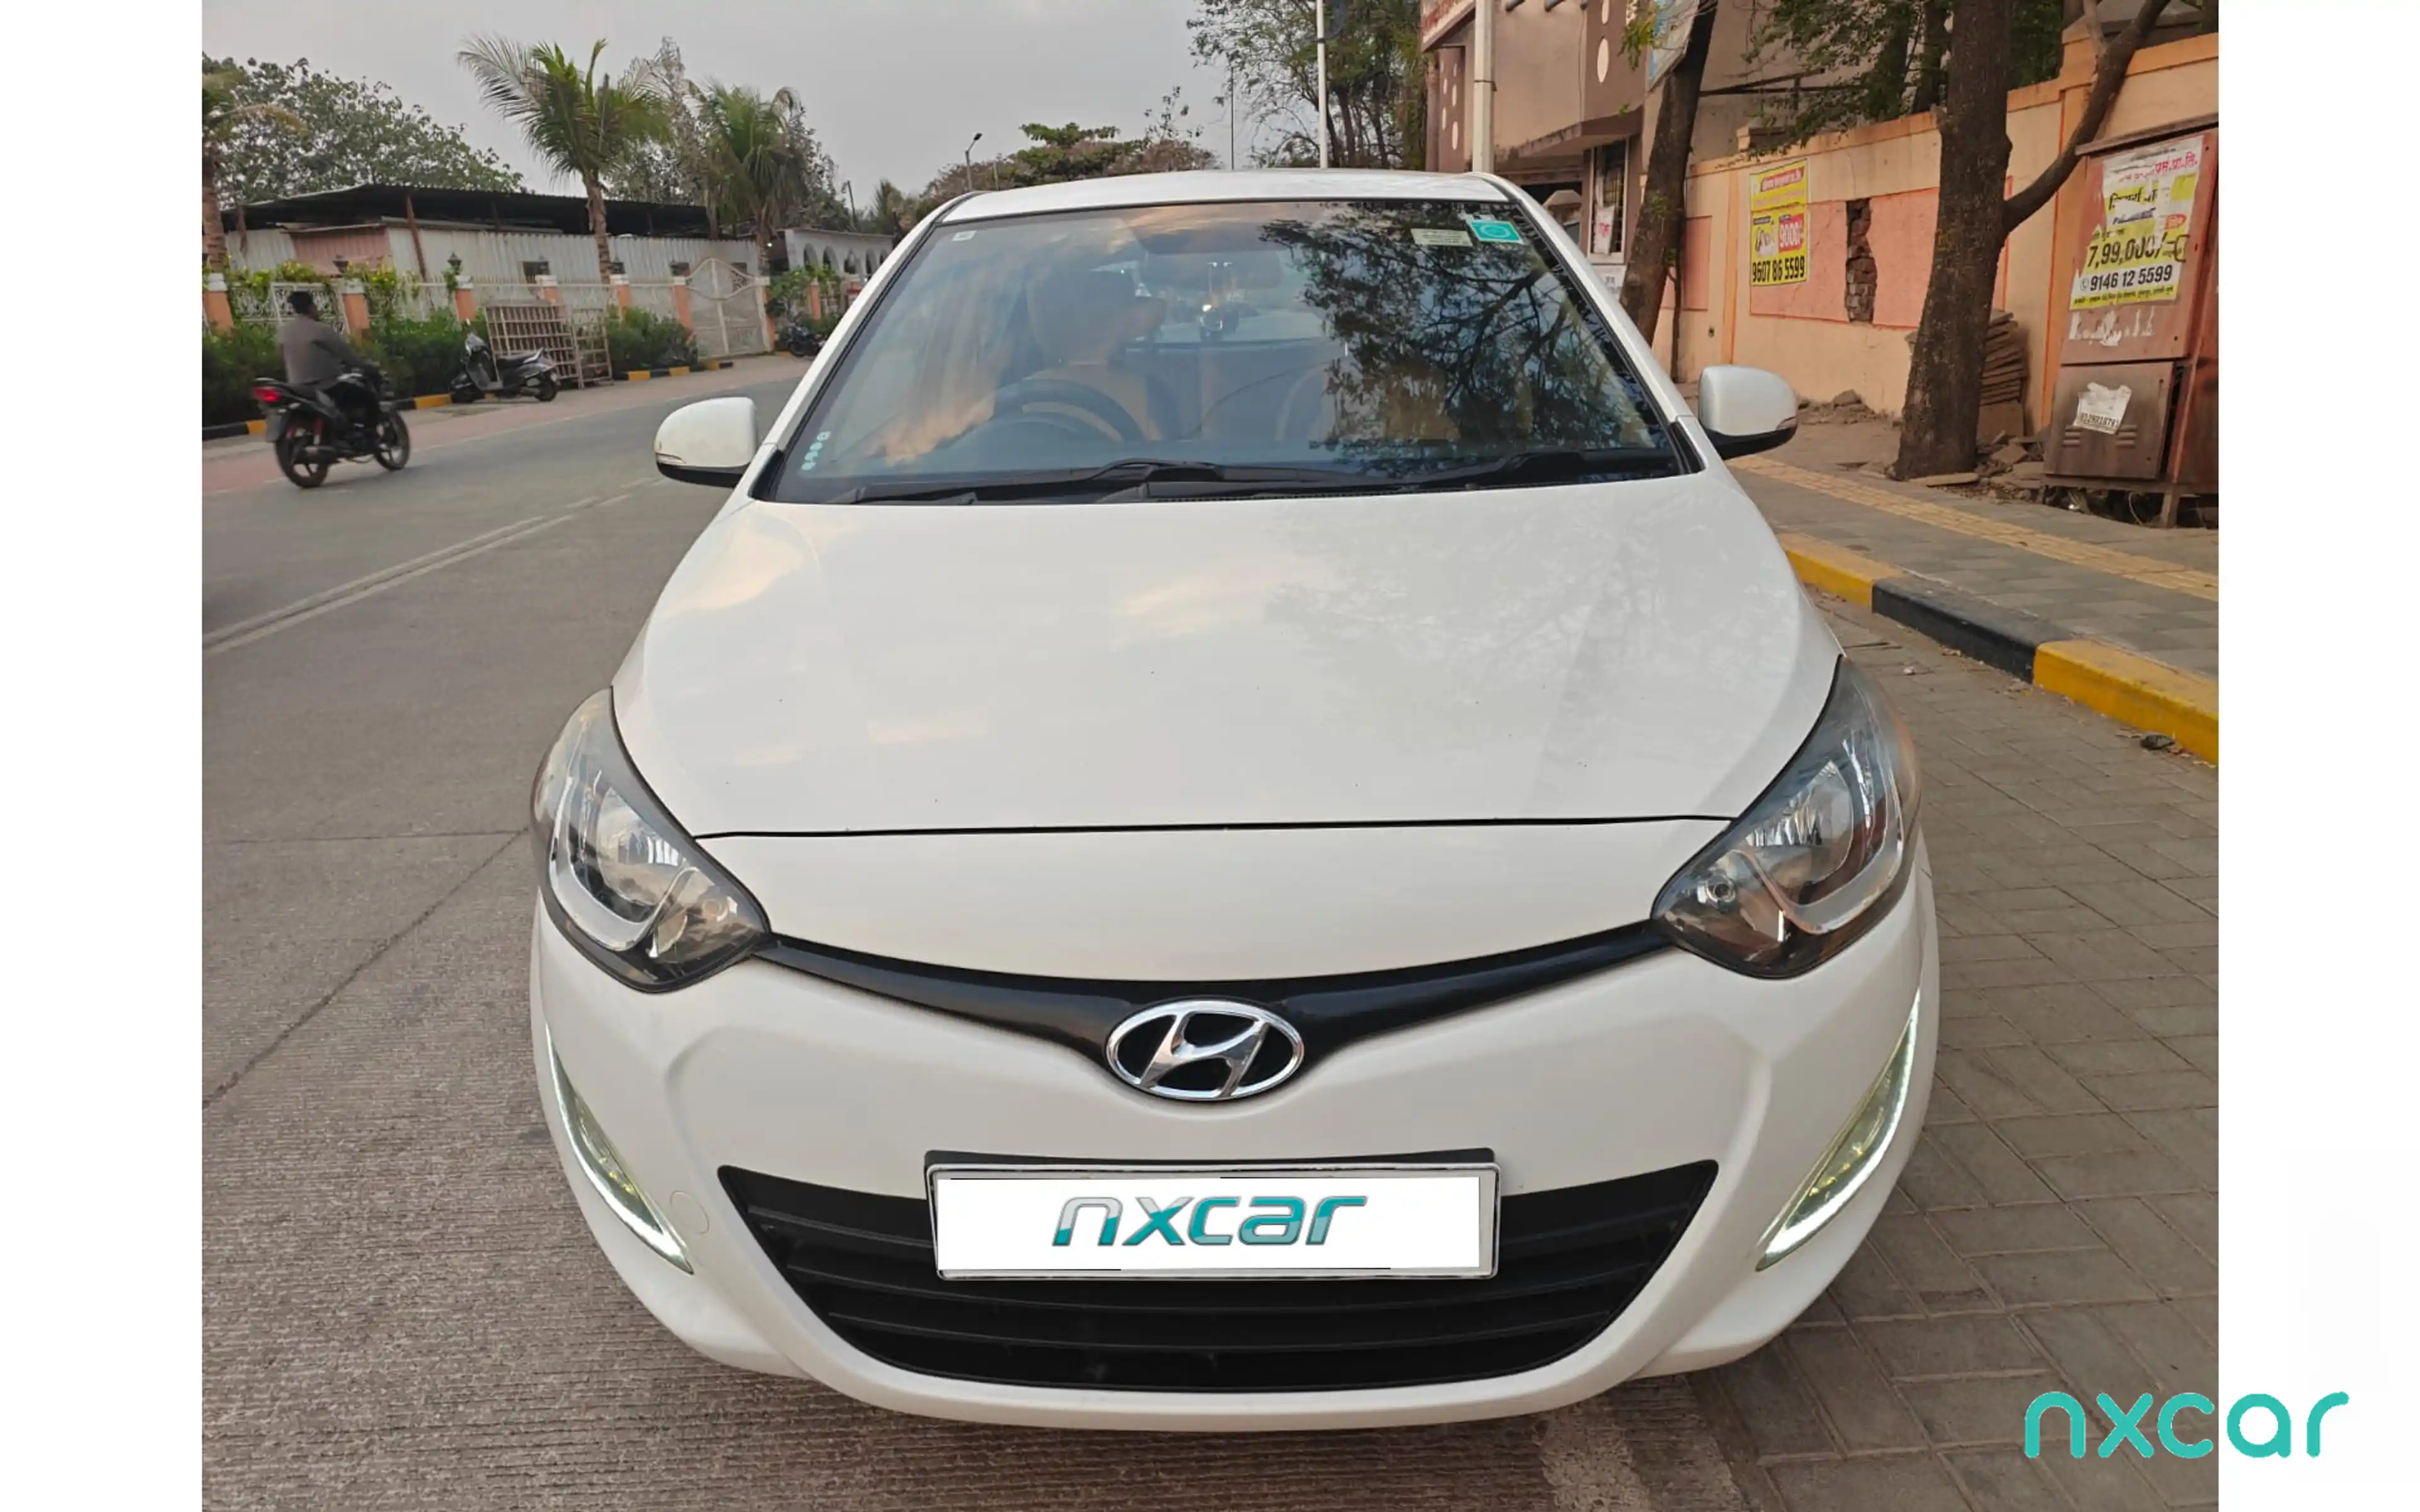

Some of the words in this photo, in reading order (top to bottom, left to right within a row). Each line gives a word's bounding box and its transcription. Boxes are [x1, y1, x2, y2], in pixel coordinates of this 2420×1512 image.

[1753, 260, 1770, 283] 9607
[1772, 258, 1782, 281] 86
[1784, 255, 1805, 280] 5599
[2090, 272, 2119, 291] 9146
[2123, 270, 2136, 287] 12
[2138, 265, 2173, 284] 5599
